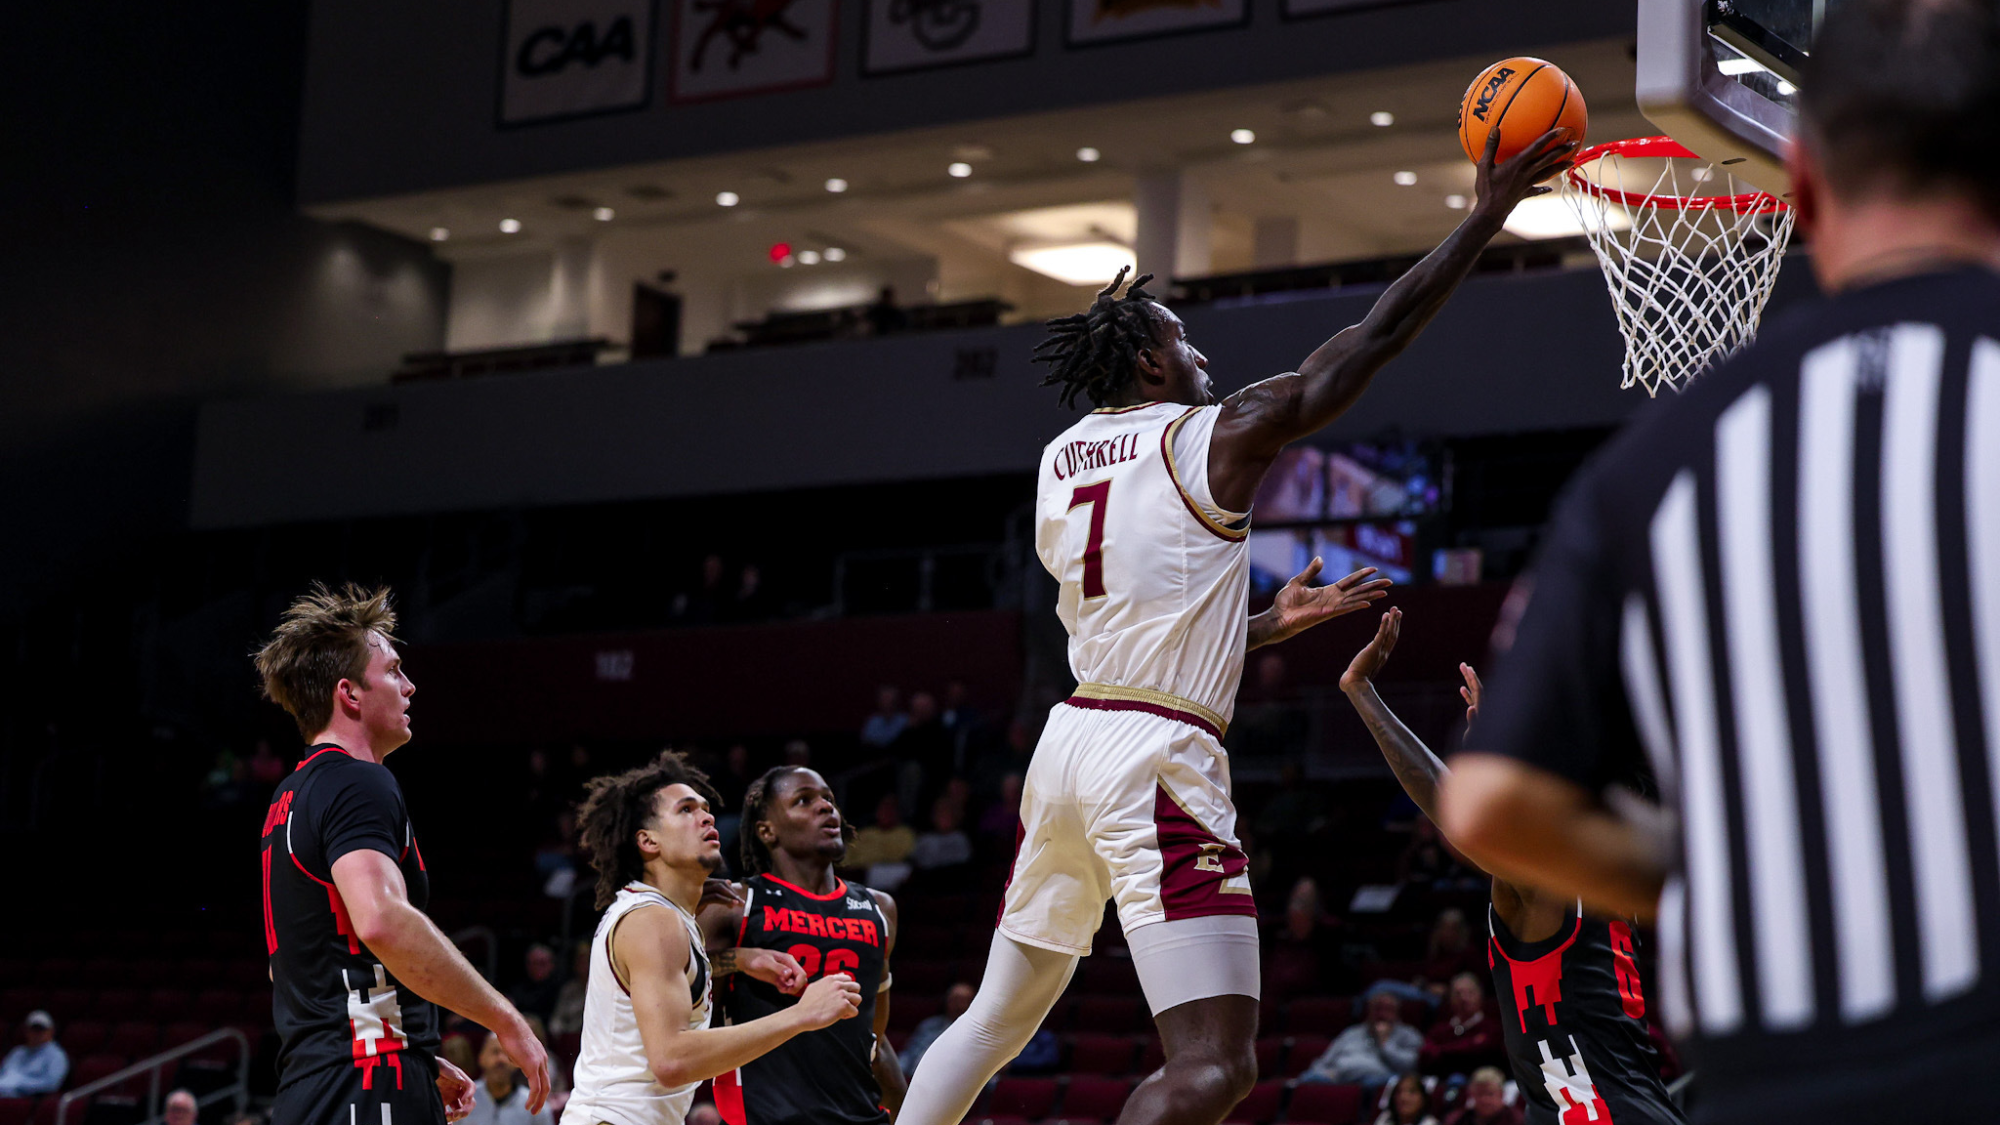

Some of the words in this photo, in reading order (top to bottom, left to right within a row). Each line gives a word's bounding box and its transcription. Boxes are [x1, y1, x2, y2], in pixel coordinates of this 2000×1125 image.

[519, 18, 632, 74] CAA
[1472, 67, 1516, 122] NCAA
[1054, 433, 1138, 480] CUTHRELL
[1066, 477, 1113, 601] 7
[763, 905, 879, 948] MERCER
